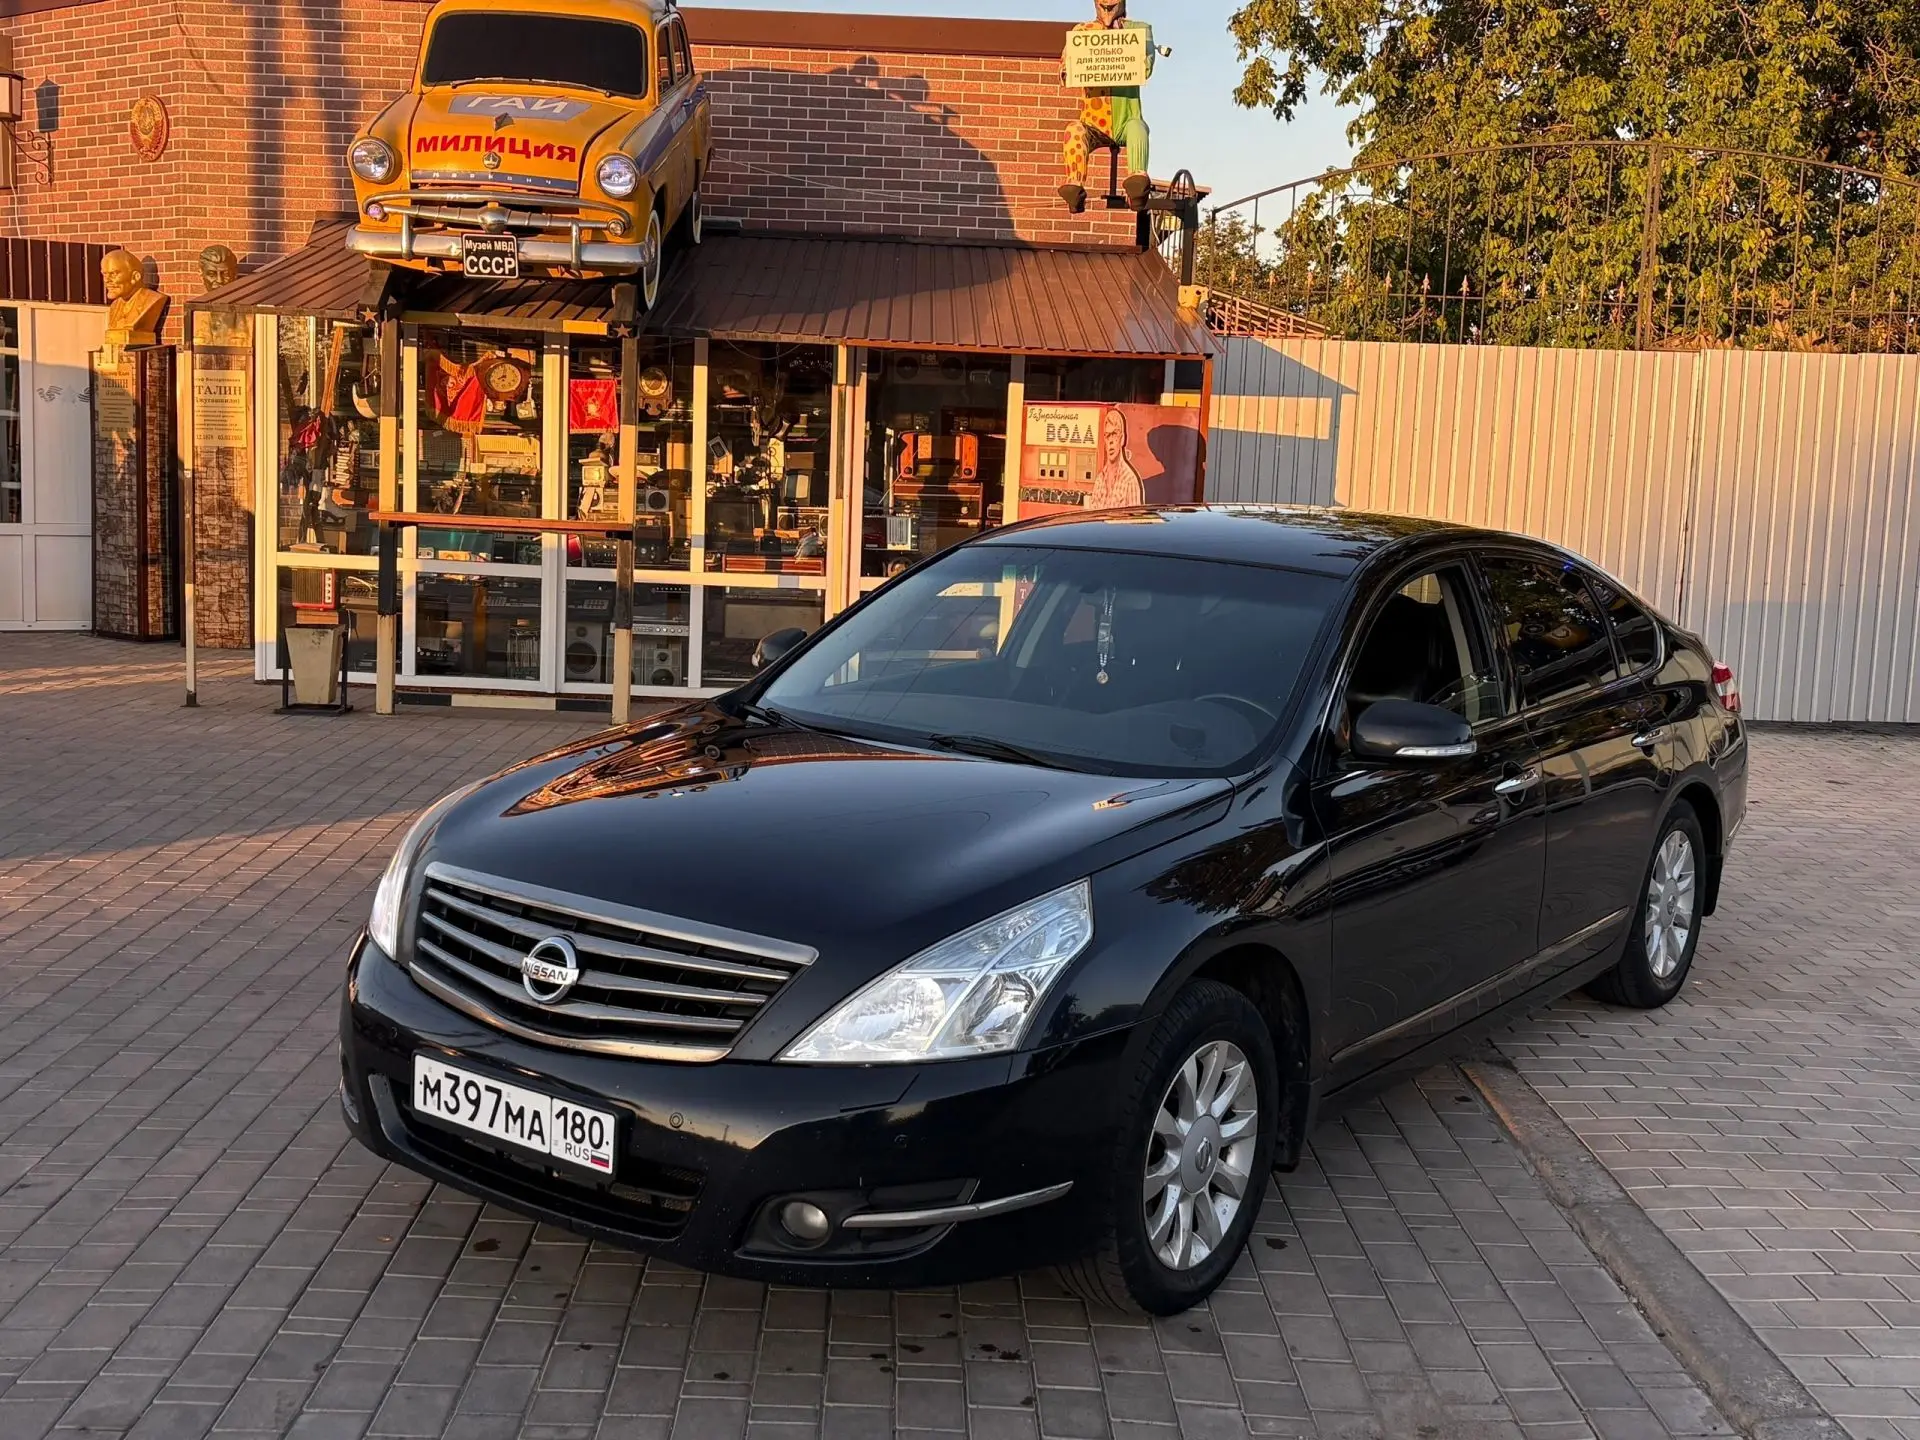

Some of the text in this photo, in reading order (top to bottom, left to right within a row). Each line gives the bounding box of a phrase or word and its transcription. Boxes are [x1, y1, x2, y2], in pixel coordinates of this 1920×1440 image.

[1072, 33, 1139, 47] СТОЯНКА
[1089, 48, 1123, 56] ТОЛЬКО
[466, 96, 568, 114] ГАИ
[416, 135, 576, 163] МИЛИЦИЯ
[465, 239, 514, 252] Музей МВД
[466, 255, 516, 275] СССР
[195, 385, 242, 396] ТАЛИН
[1028, 408, 1079, 422] Газированная
[1046, 423, 1095, 444] ВОДА
[523, 961, 568, 982] NISSAN
[555, 1106, 604, 1150] 180
[564, 1142, 590, 1161] RUS
